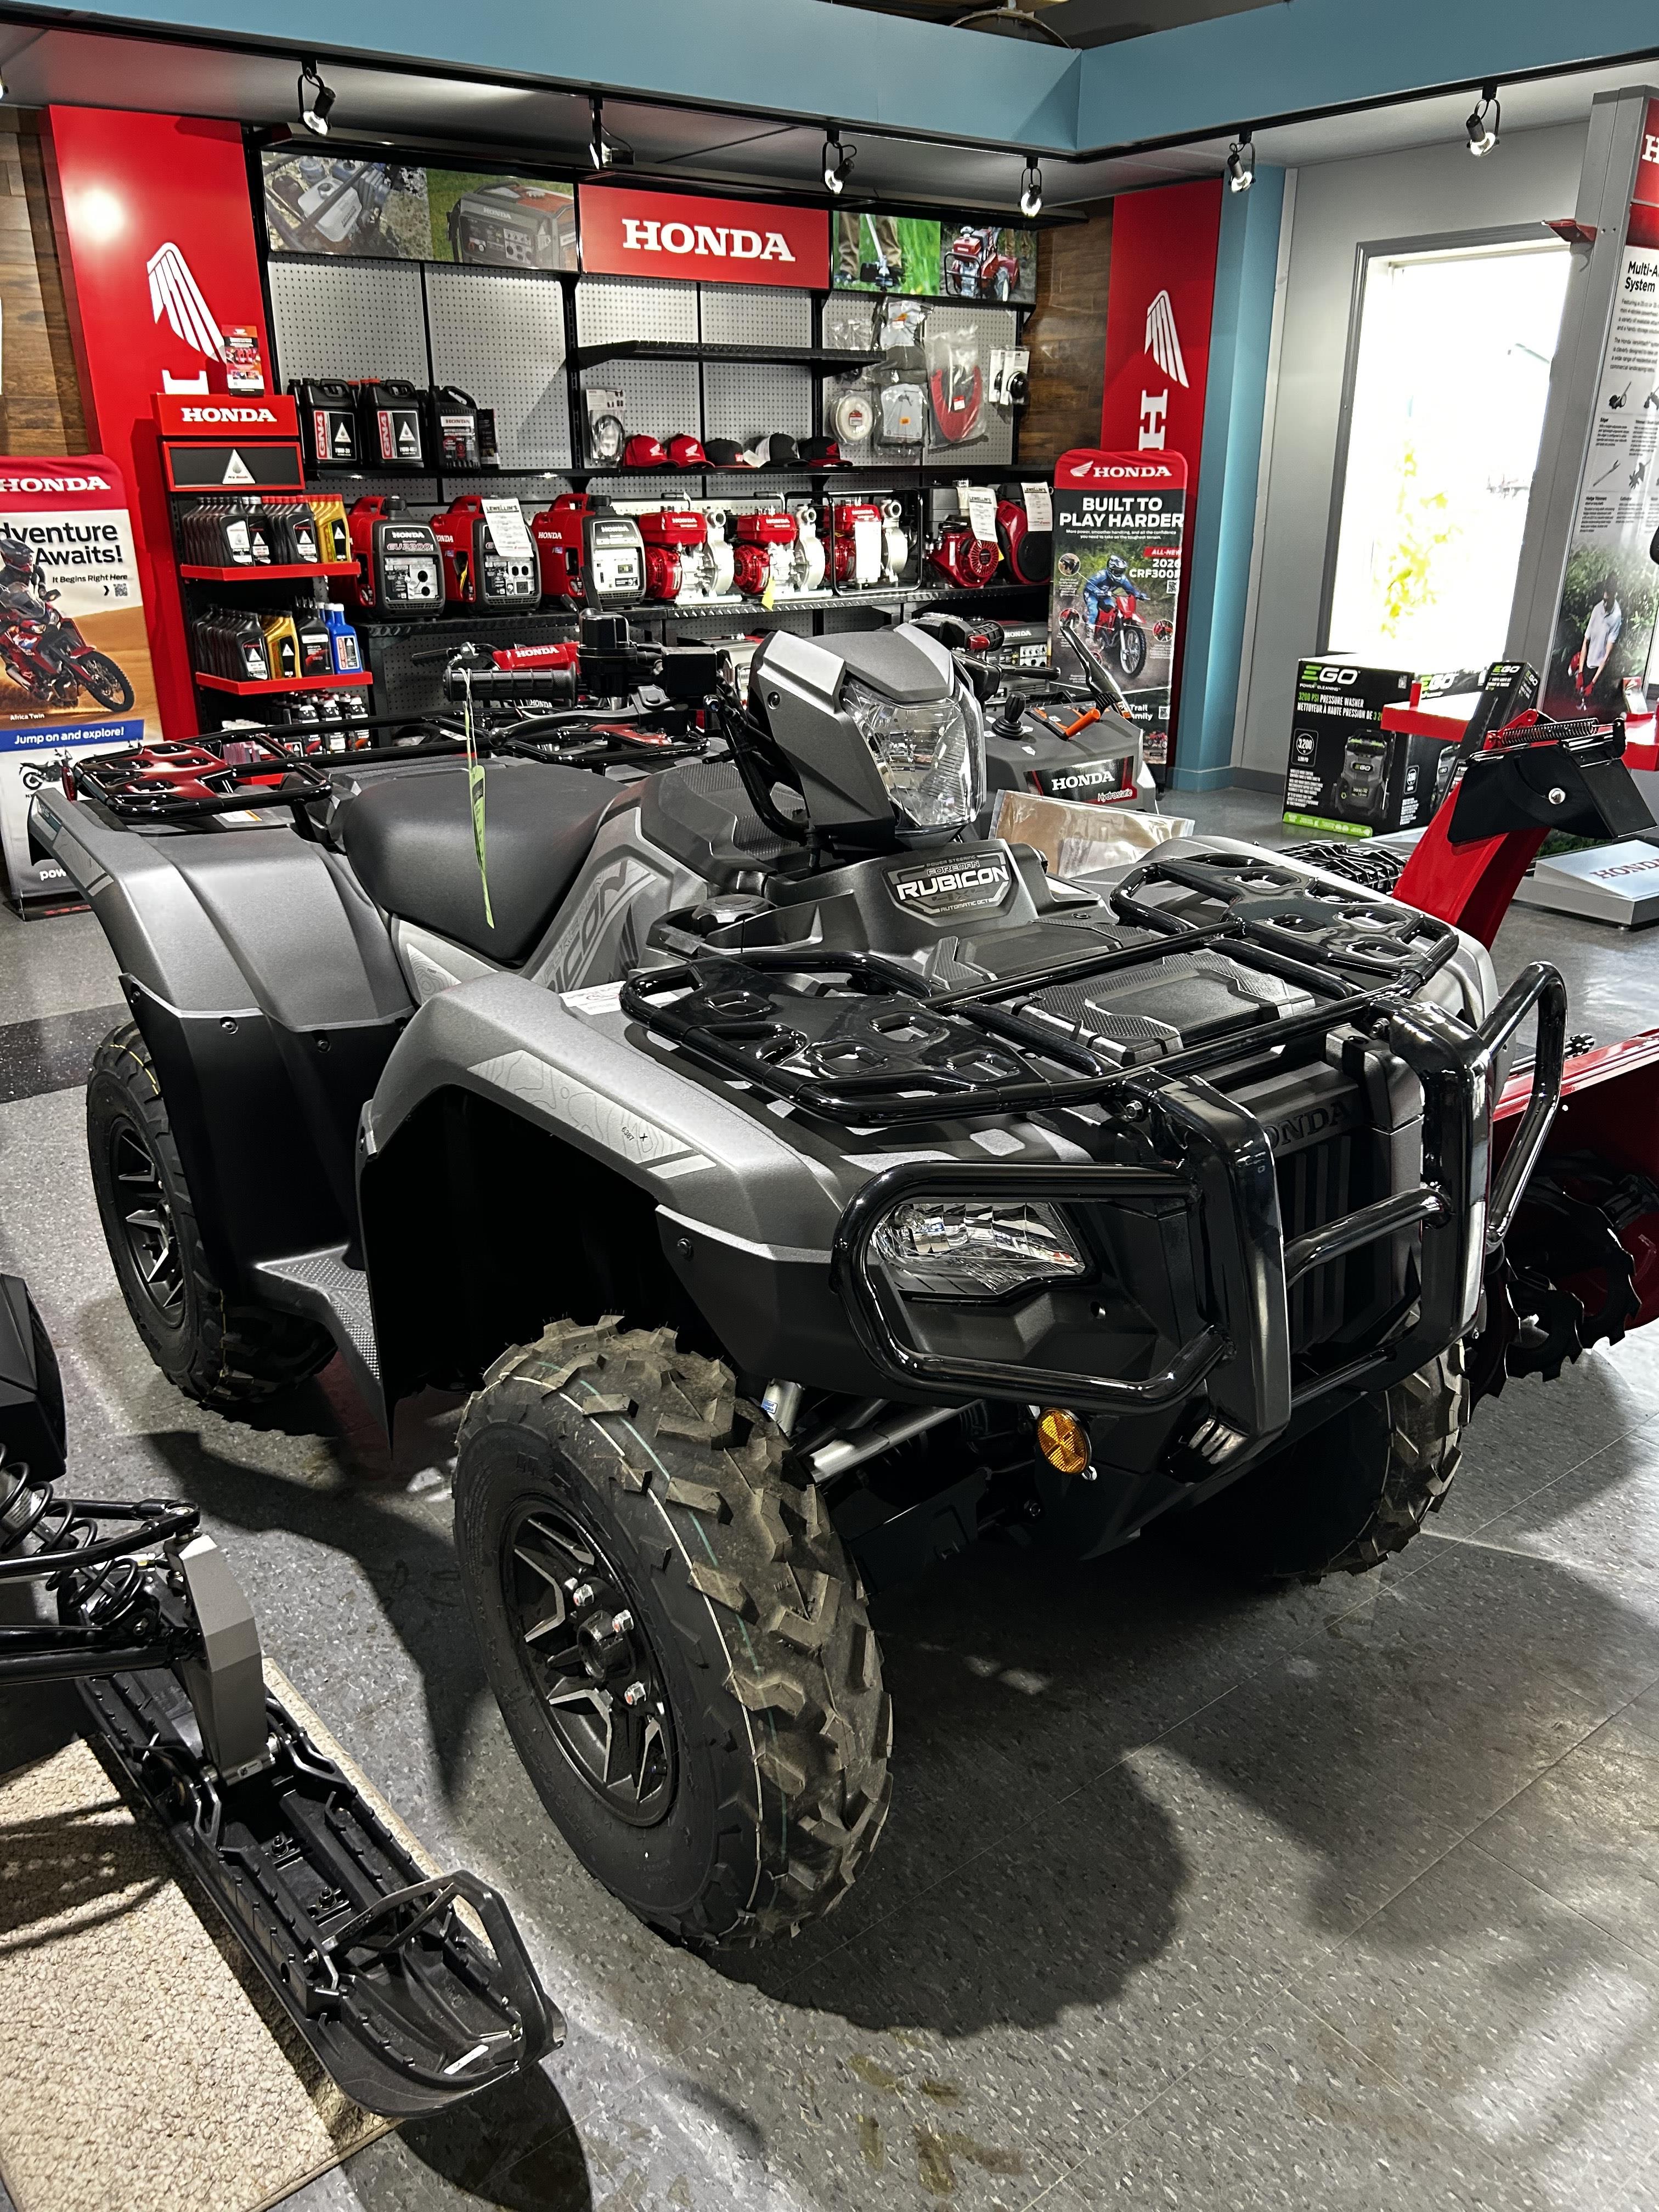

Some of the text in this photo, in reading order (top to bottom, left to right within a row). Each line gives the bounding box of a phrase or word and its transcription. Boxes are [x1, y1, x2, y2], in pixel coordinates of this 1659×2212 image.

[483, 206, 512, 220] HONDA
[622, 218, 796, 262] HONDA
[1628, 261, 1659, 278] Multi-A
[1624, 276, 1656, 292] System
[180, 408, 277, 422] HONDA
[317, 414, 326, 456] GN4
[381, 415, 392, 456] GN4
[1093, 466, 1172, 478] HONDA
[0, 476, 111, 492] HONDA
[1082, 497, 1163, 511] BUILT TO
[1059, 512, 1184, 528] PLAY HARDER
[0, 523, 118, 543] dventure
[35, 545, 123, 565] Awaits!
[1153, 558, 1181, 568] 2026
[60, 575, 86, 584] Begins
[88, 574, 109, 583] Right
[516, 646, 560, 658] HONDA
[1301, 665, 1358, 685] EGO
[1492, 665, 1521, 673] EGO
[1420, 673, 1459, 691] EGO
[529, 699, 553, 708] HONDA
[1299, 691, 1364, 708] 3200 PSI PRESSURE WASHER
[1297, 702, 1323, 714] NETTOYEUR
[1328, 706, 1342, 716] HAUTE
[1342, 707, 1365, 719] PRESSION
[1366, 710, 1373, 720] DE
[14, 726, 125, 744] Jump on and explore!
[1297, 738, 1313, 750] 3200
[1051, 771, 1115, 791] HONDA
[1097, 788, 1133, 802] Hydrostatic
[926, 855, 976, 867] POWER STEERING
[927, 860, 980, 877] FOREMAN
[1590, 859, 1659, 879] HOND
[40, 868, 66, 881] pow
[896, 865, 1009, 900] RUBICON
[940, 900, 977, 912] AUTOMATIC
[1264, 1101, 1347, 1150] ONDA
